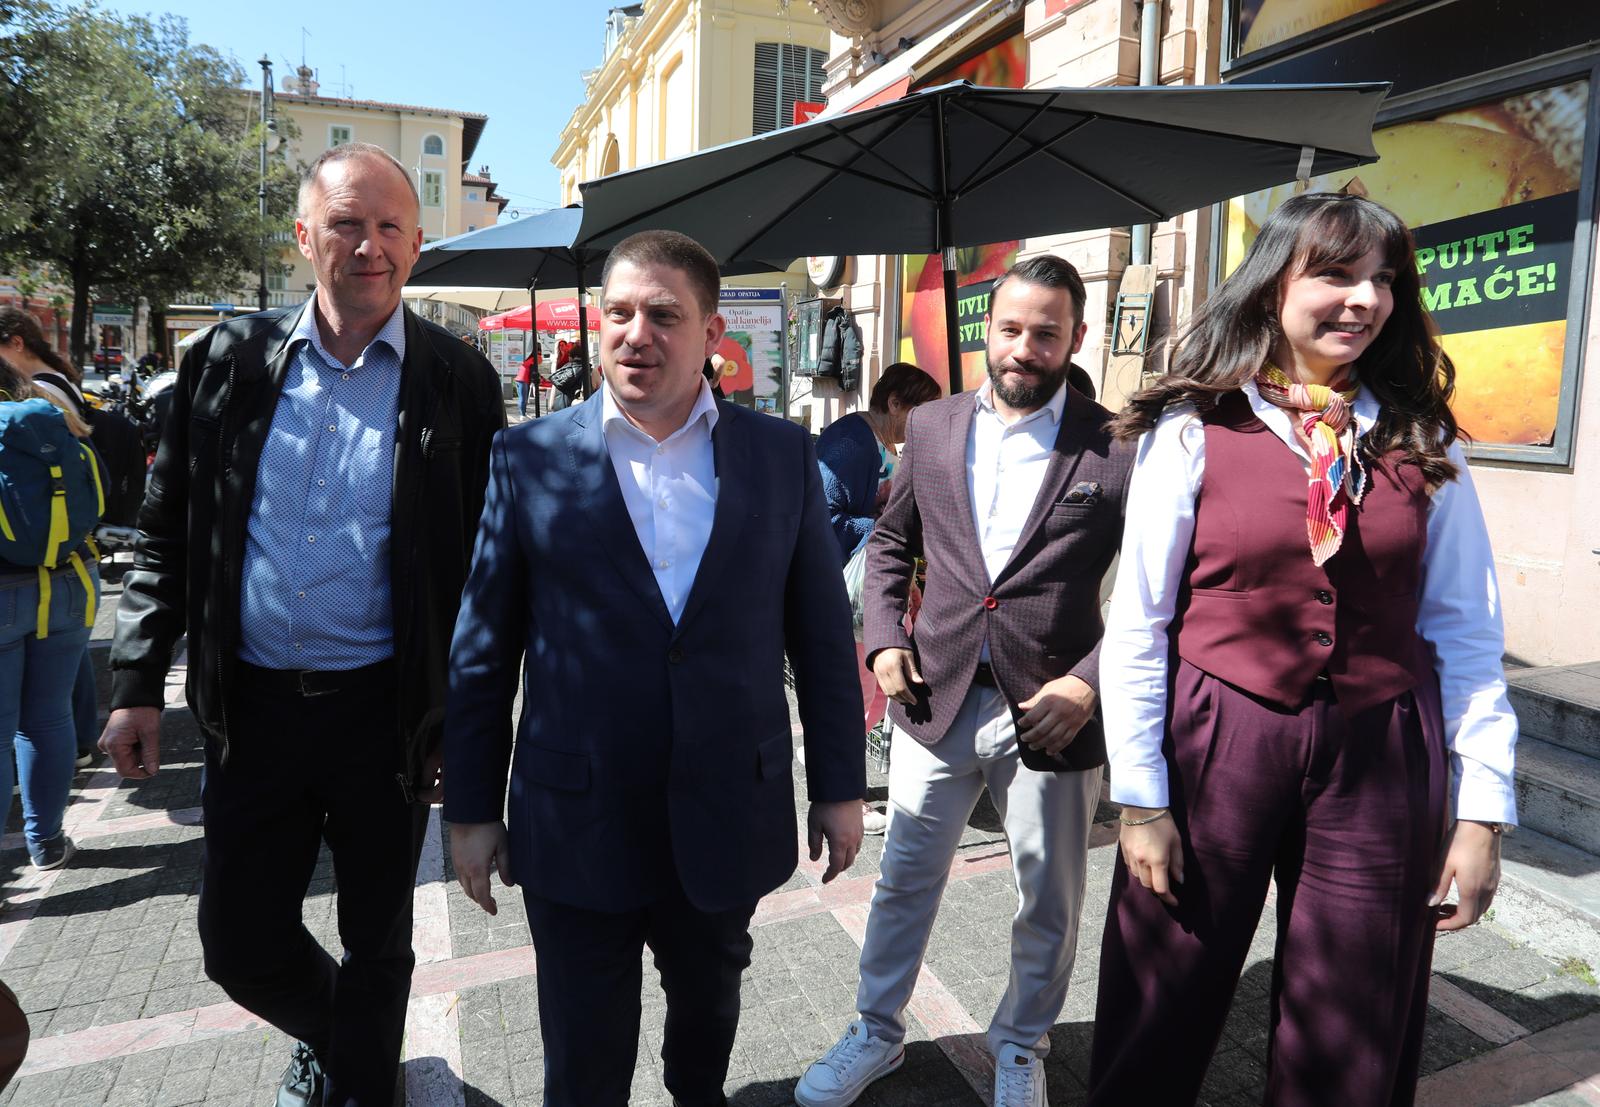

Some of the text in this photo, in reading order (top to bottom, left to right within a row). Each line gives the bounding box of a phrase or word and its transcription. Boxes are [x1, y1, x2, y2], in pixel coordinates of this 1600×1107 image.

[1415, 223, 1534, 275] PUJTE
[1420, 262, 1556, 312] MAĆE!
[555, 304, 575, 313] SDP
[958, 293, 990, 317] UVIJ
[726, 316, 771, 325] ival kamelija
